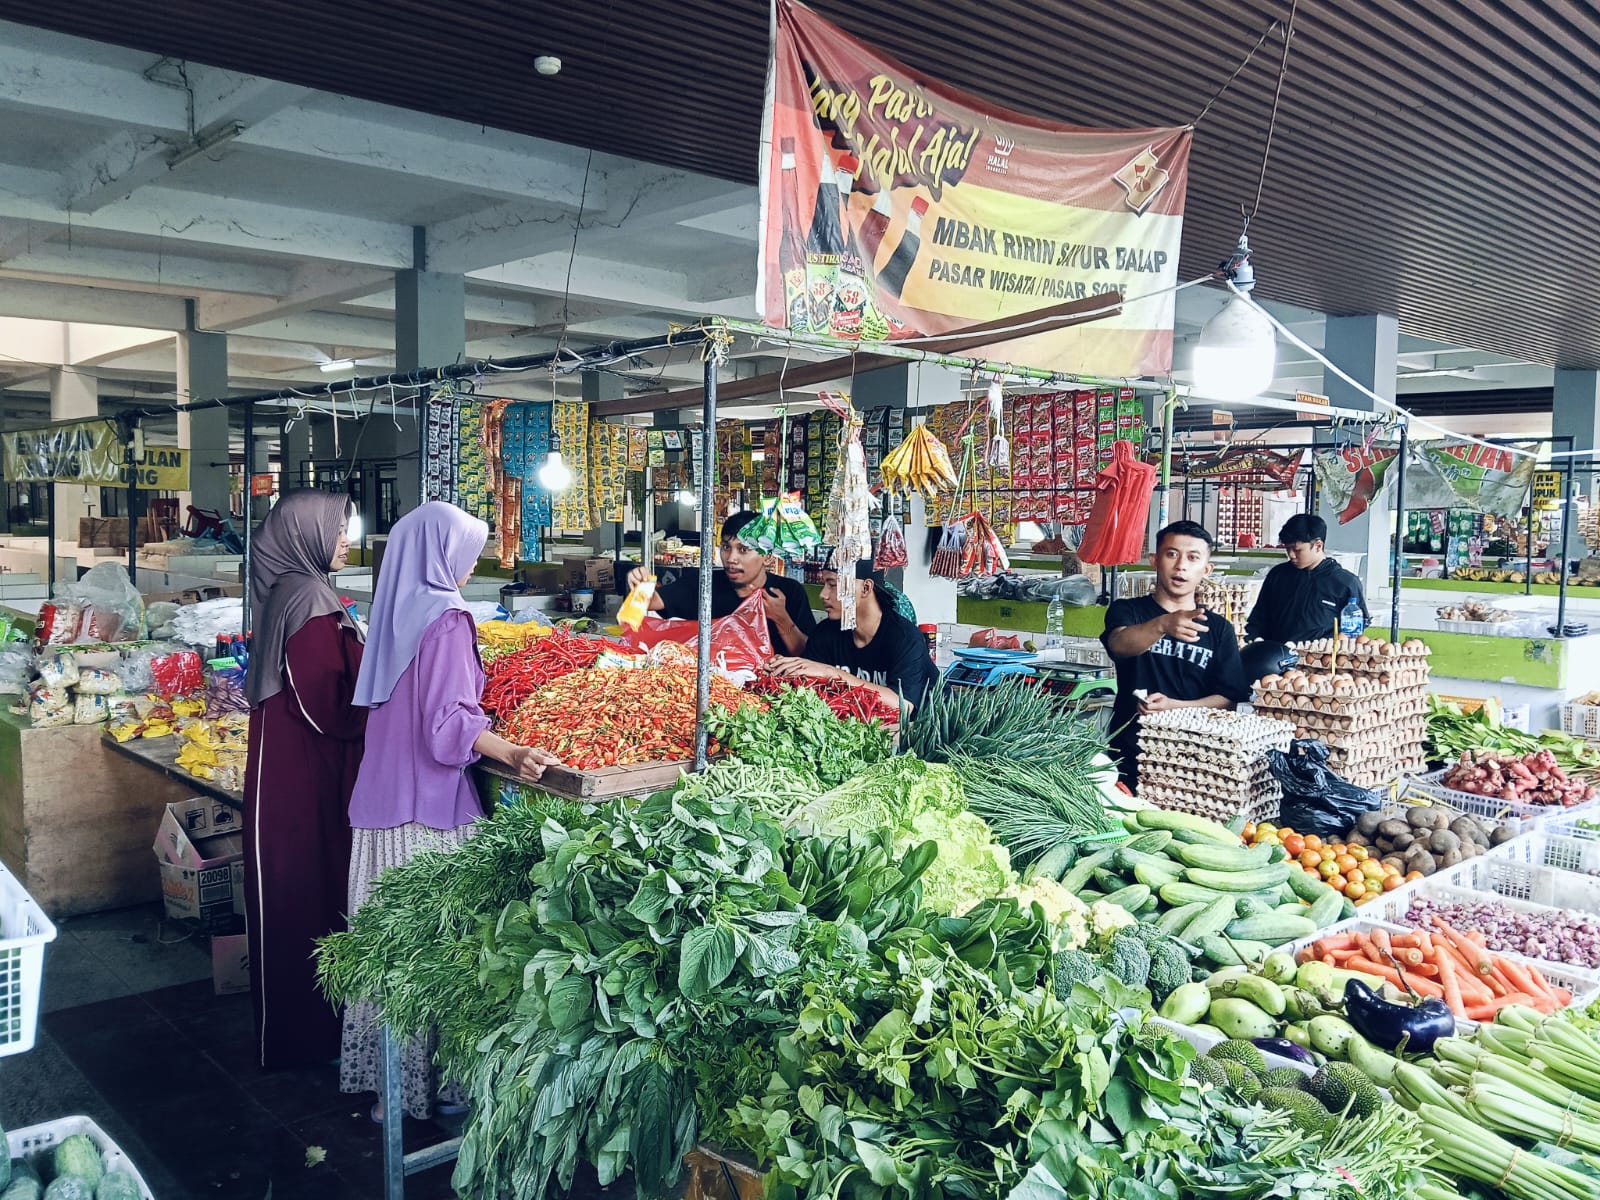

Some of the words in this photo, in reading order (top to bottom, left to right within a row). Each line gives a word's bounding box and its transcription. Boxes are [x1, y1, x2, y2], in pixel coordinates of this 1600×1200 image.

[920, 127, 980, 189] Aja!
[987, 155, 1009, 170] HALAL
[932, 216, 998, 256] MBAK
[1003, 232, 1055, 265] RIRIN
[1057, 242, 1111, 270] SAYUR
[1116, 246, 1168, 274] BALAP
[928, 258, 986, 288] PASAR
[843, 289, 860, 305] 58
[1147, 638, 1214, 670] ERATE
[200, 867, 229, 885] 20098
